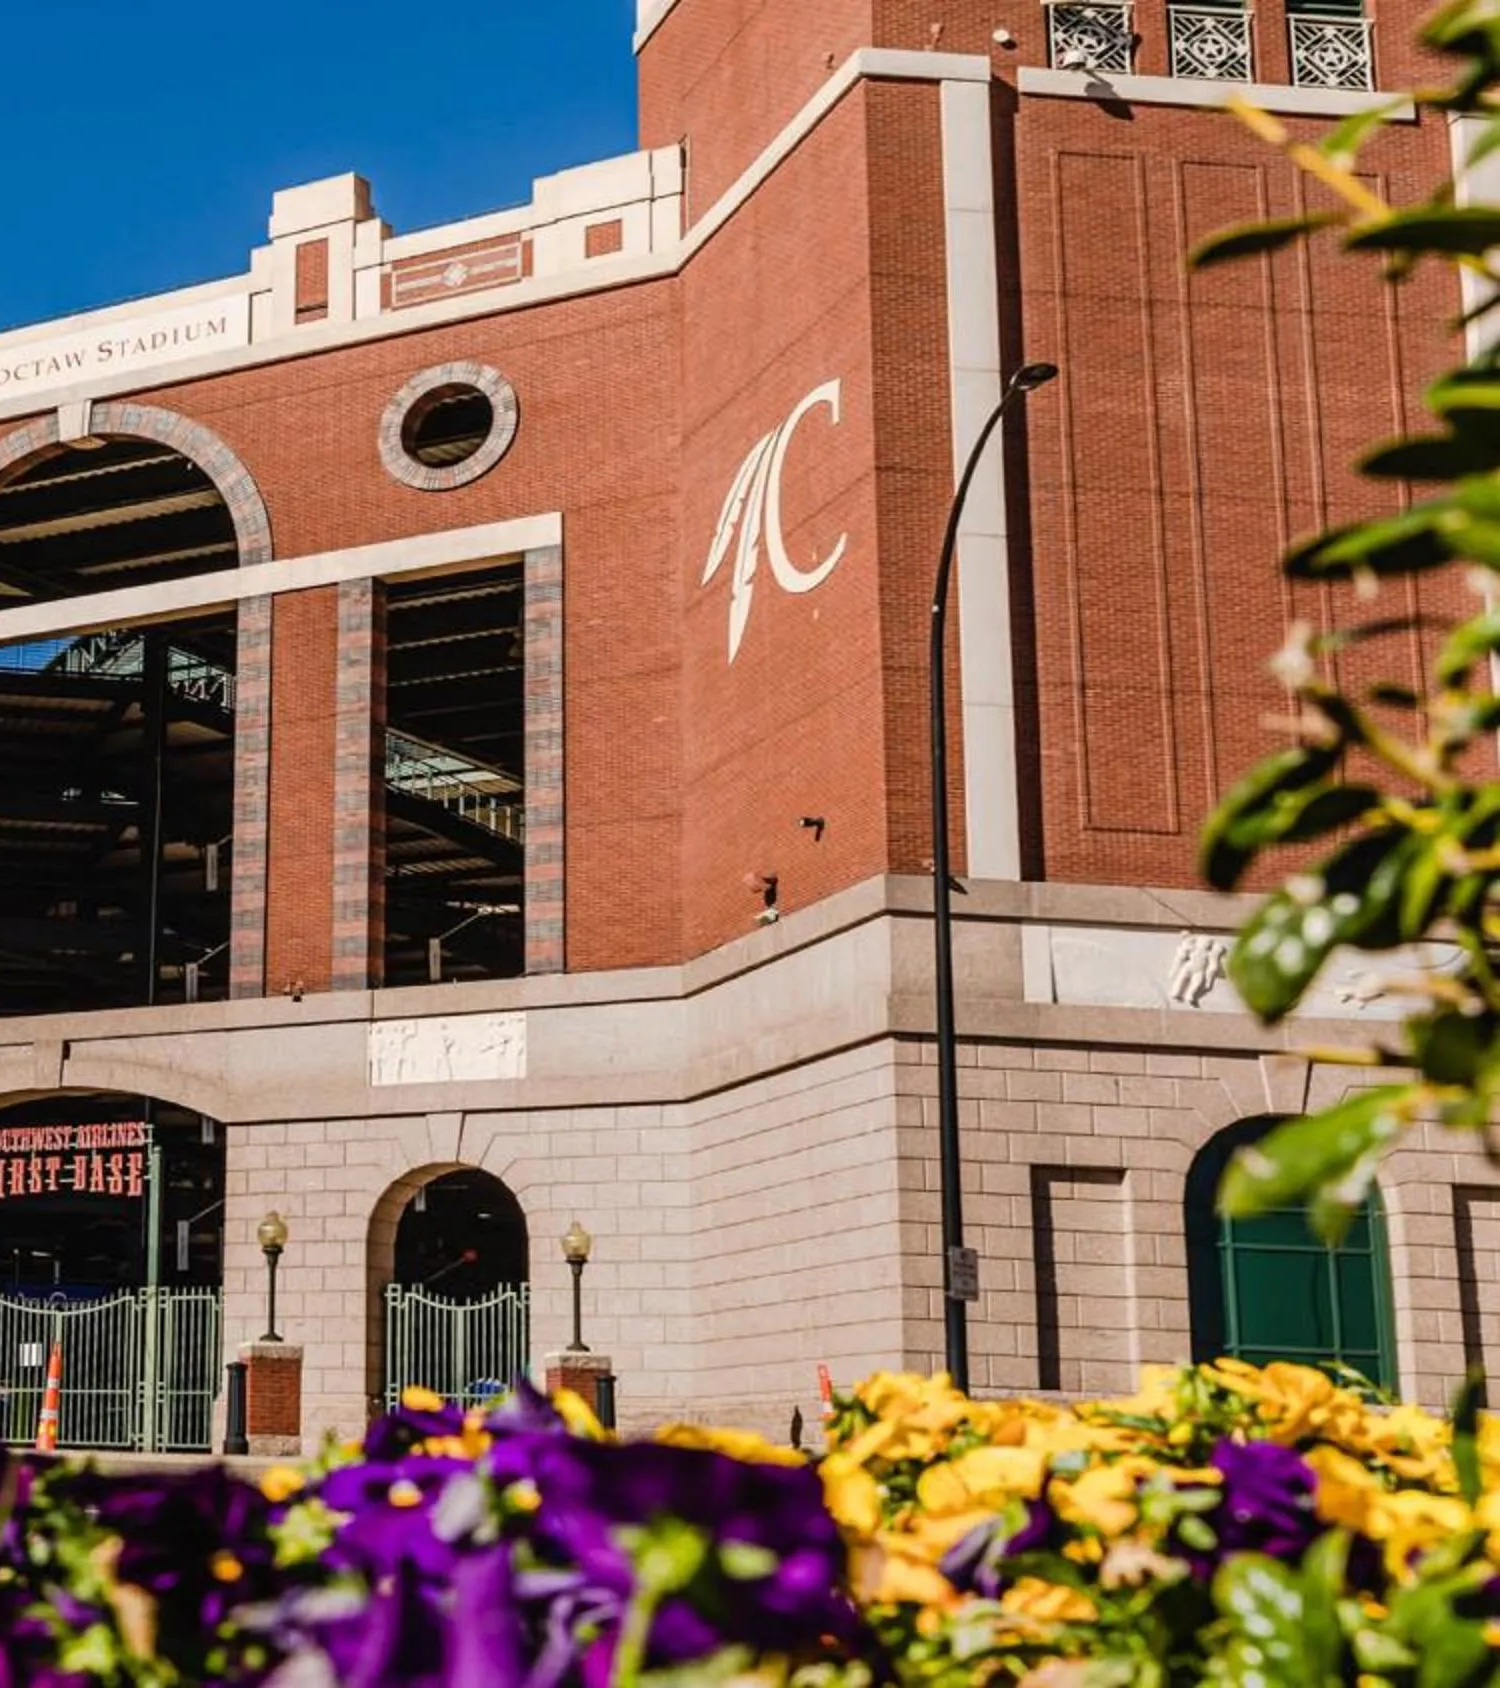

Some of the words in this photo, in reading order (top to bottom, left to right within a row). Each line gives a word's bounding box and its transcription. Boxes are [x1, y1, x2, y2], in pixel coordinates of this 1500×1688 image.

[97, 316, 229, 364] STADIUM
[74, 1120, 147, 1150] AIRLINES
[71, 1151, 144, 1198] BASE
